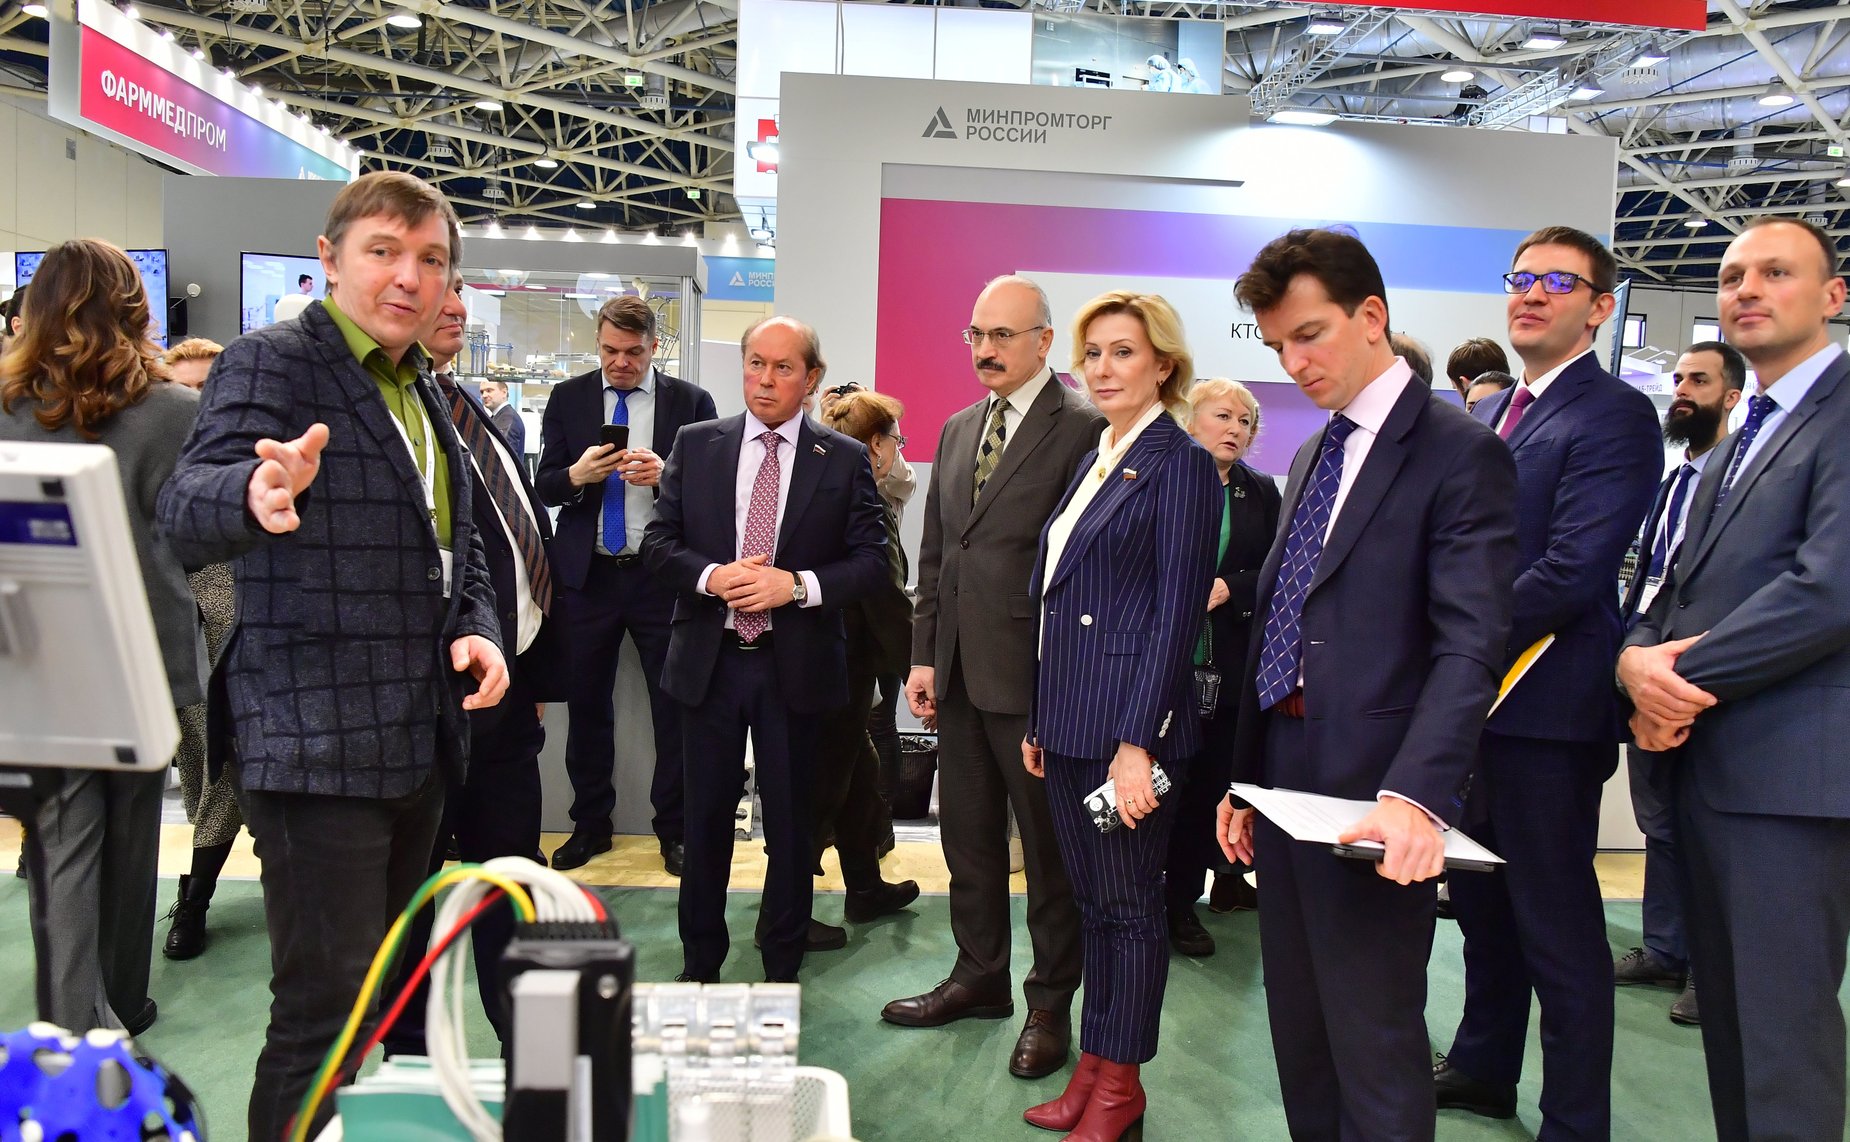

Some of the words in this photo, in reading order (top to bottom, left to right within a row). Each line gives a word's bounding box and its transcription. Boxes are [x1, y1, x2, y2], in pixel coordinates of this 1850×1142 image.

[101, 70, 227, 152] ФАРММЕДПРОМ
[967, 108, 1112, 130] МИНПРОМТОРГ
[966, 125, 1047, 144] РОССИИ
